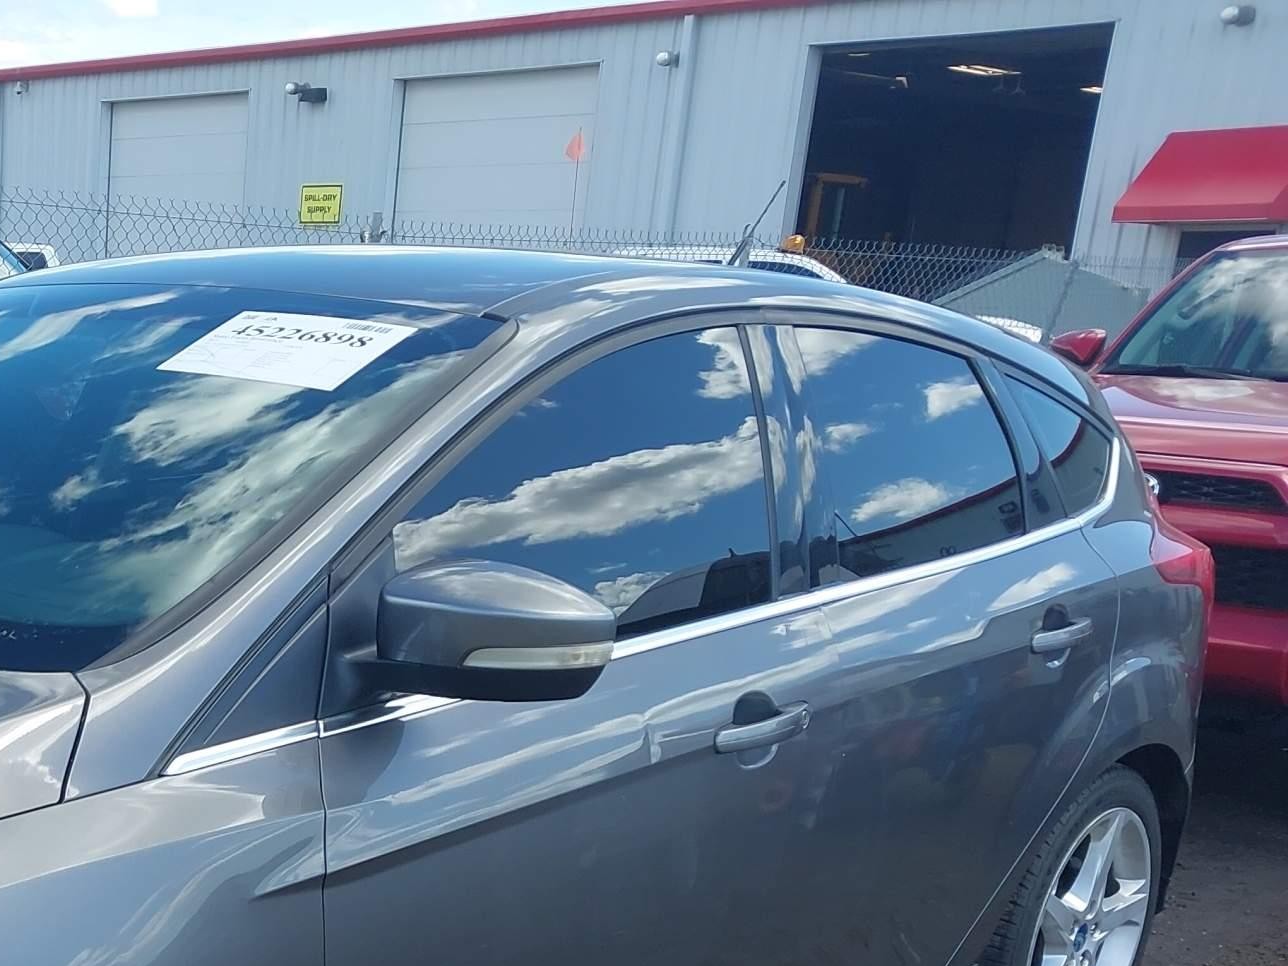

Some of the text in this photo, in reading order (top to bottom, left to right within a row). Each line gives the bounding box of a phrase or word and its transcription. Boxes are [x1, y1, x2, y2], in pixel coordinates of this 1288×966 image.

[304, 194, 338, 202] SPILL-DRY
[307, 205, 332, 214] SUPPLY
[231, 323, 375, 349] 45226898
